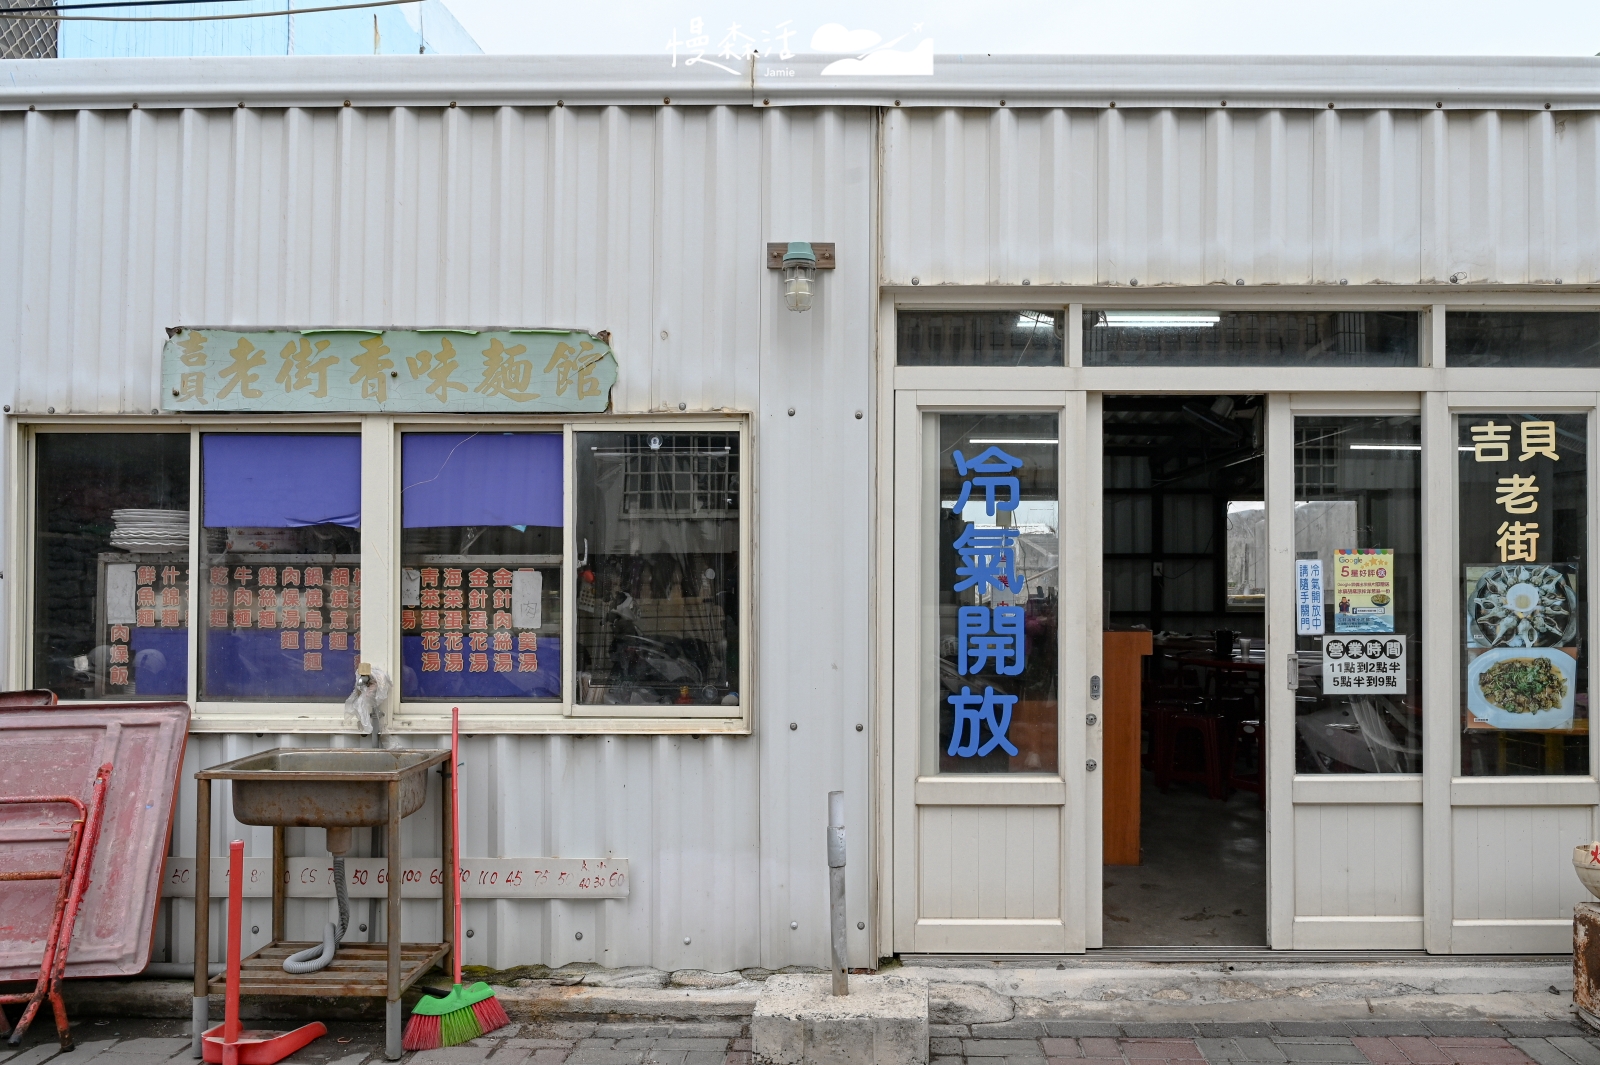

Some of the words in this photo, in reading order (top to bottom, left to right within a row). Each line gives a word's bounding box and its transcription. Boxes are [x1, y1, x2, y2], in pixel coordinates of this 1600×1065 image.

[1470, 421, 1560, 462] 吉貝
[1495, 473, 1540, 563] 老街
[1338, 556, 1363, 565] Google
[136, 566, 156, 628] 鮮魚麵
[161, 566, 180, 628] 什錦麵
[210, 566, 229, 628] 乾拌麵
[233, 566, 253, 628] 牛肉麵
[258, 567, 277, 629] 雞絲麵
[280, 566, 301, 650] 肉燥湯麵
[303, 566, 323, 671] 鍋燒烏龍麵
[329, 567, 350, 651] 鍋燒意麵
[420, 567, 441, 672] 青菜蛋花湯
[443, 567, 464, 672] 海菜蛋花湯
[468, 567, 488, 672] 金針蛋花湯
[493, 567, 512, 672] 金針肉絲湯
[947, 446, 1026, 757] 冷氣開放
[1299, 564, 1311, 631] 請隨手關門
[1311, 563, 1322, 630] 冷氣開放中
[110, 624, 130, 686] 肉燥飯
[1328, 641, 1401, 658] 營業時間
[1330, 662, 1401, 673] 11點到2點半
[1333, 675, 1397, 688] 5點半到9點
[351, 869, 369, 885] 50
[402, 870, 422, 885] 100
[479, 870, 498, 885] 110
[505, 870, 523, 886] 45
[609, 872, 625, 887] 60
